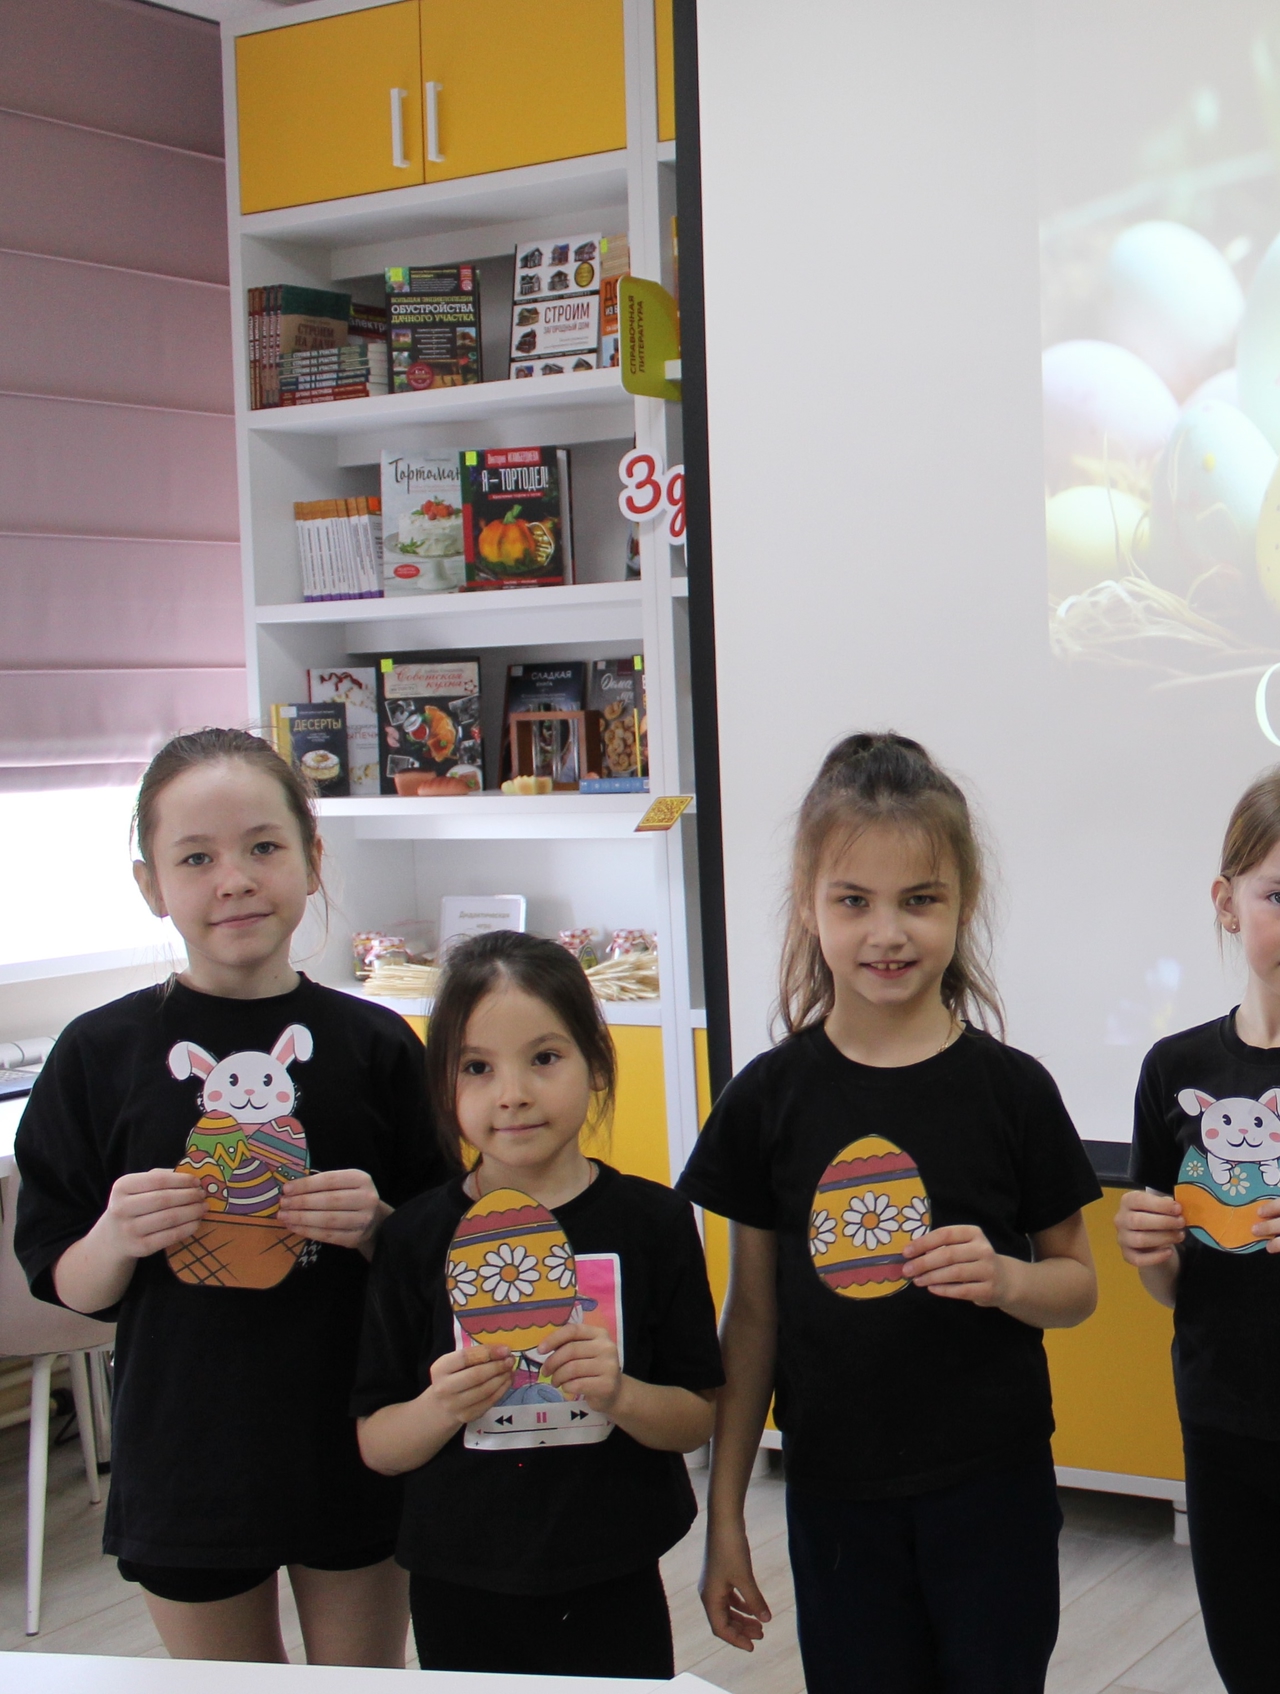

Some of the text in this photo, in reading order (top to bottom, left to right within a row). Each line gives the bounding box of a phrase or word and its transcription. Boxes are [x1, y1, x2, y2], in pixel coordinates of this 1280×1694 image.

[391, 302, 474, 314] ОБУСТРОЙСТВА
[544, 302, 590, 324] СТРОИМ
[391, 313, 475, 324] ДАЧНОГО УЧАСТКА
[628, 295, 637, 375] СПРАВОЧНАЯ
[637, 300, 646, 373] ЛИТЕРАТУРА
[481, 470, 489, 492] Я
[499, 466, 549, 491] ТОРТОДЕЛ!
[531, 670, 573, 681] СЛАДКАЯ
[293, 718, 342, 732] ДЕСЕРТЫ
